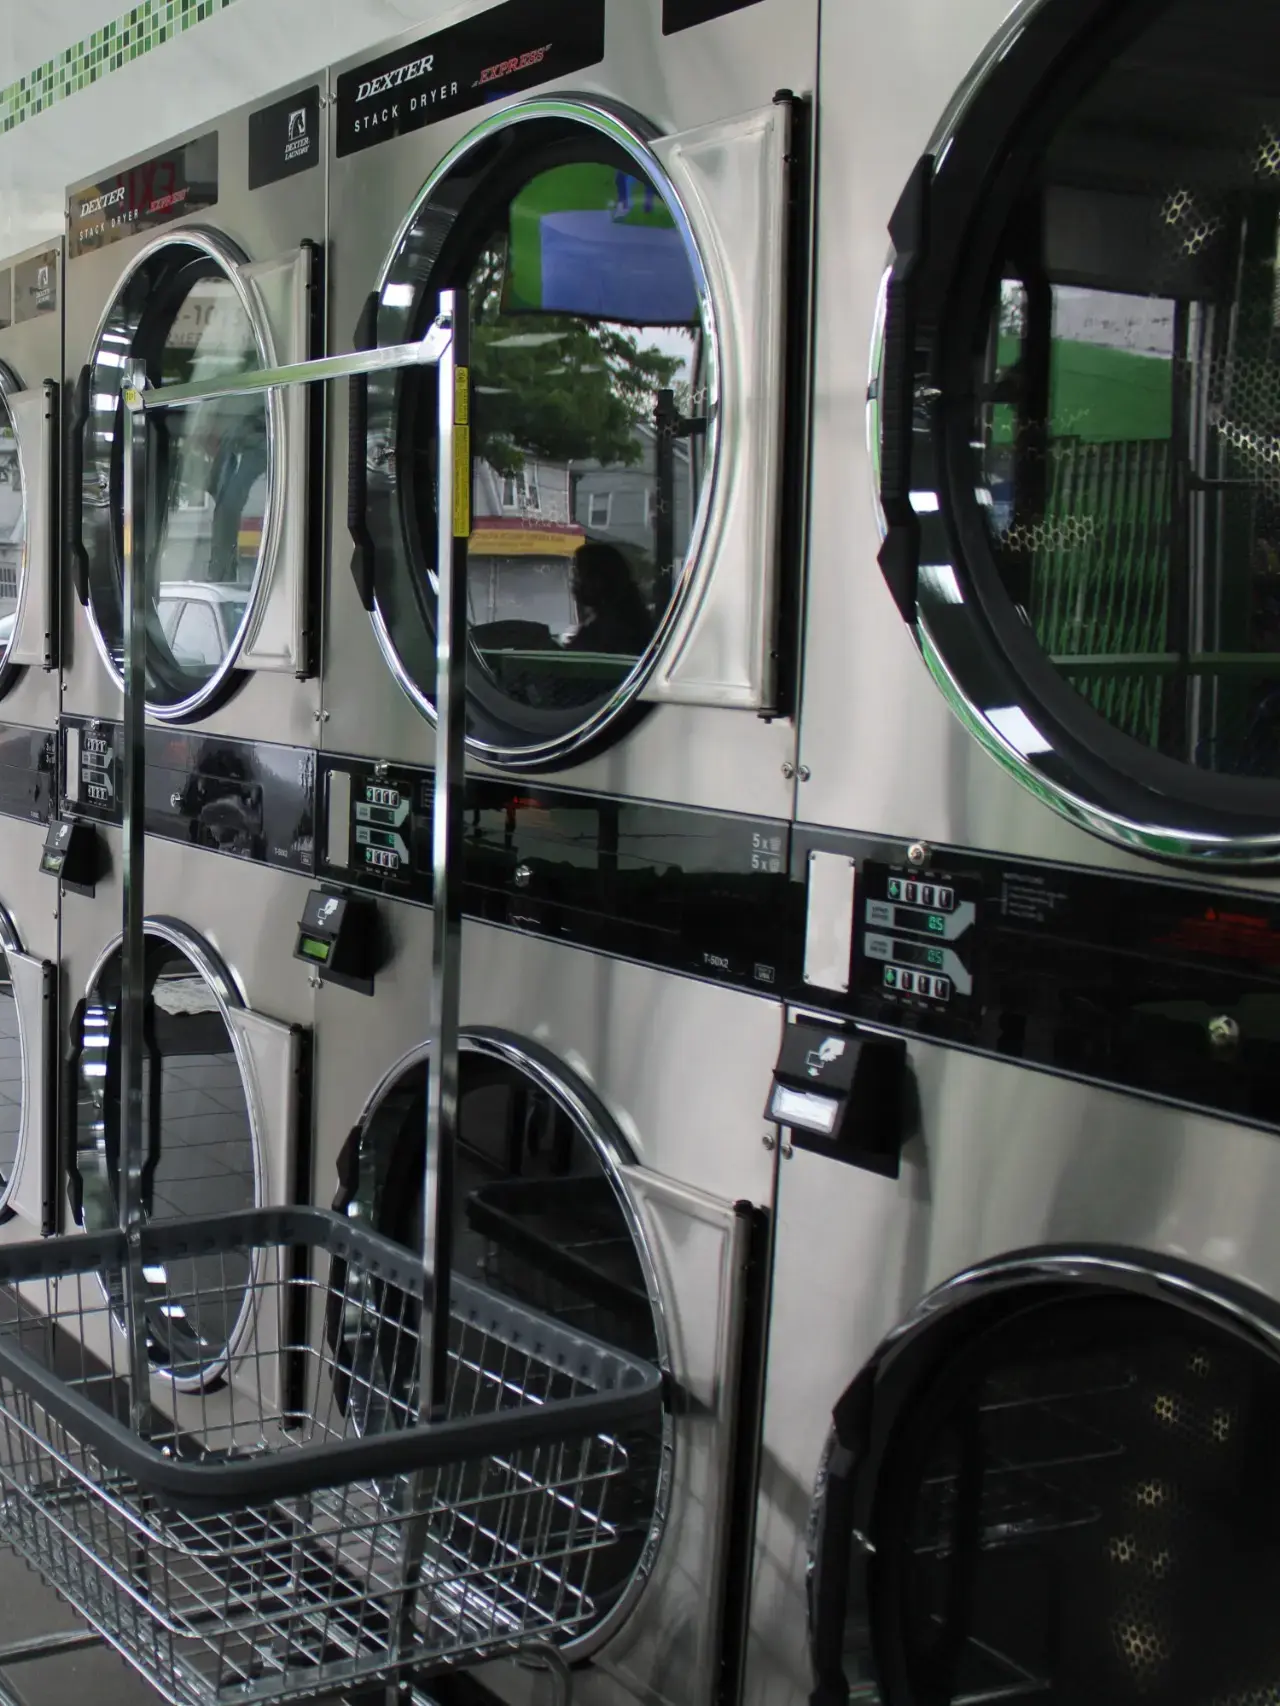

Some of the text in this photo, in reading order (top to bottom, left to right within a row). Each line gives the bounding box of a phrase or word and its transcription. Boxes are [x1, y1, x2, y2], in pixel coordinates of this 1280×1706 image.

[356, 48, 546, 102] DEXTER EXPRESS
[354, 81, 459, 133] STACK DRYER
[284, 145, 309, 161] LAUNDRY
[285, 136, 309, 153] DEXTER
[80, 187, 125, 217] DEXTER
[79, 208, 139, 241] STACK DRYER
